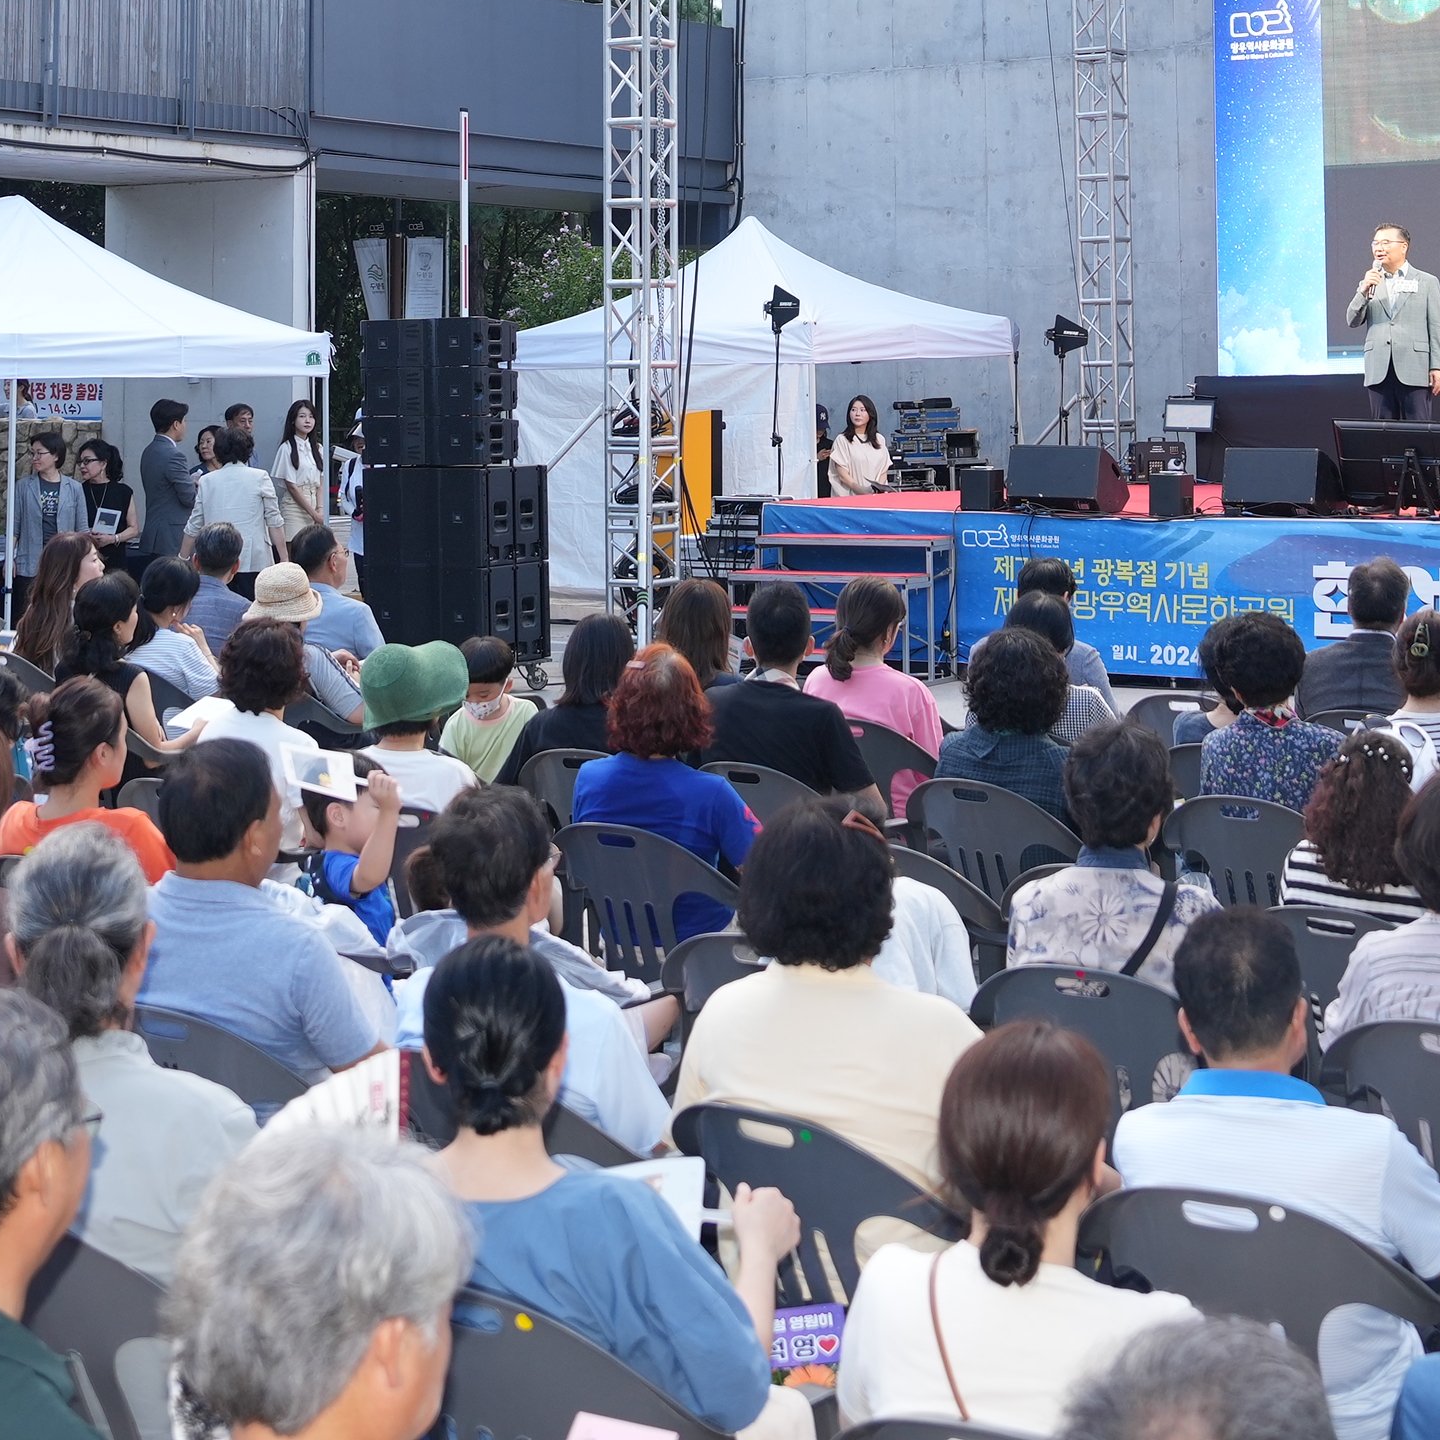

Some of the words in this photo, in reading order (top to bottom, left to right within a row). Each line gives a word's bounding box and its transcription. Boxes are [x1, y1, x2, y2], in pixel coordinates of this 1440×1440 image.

[1230, 38, 1294, 54] 망우역사문화공원
[50, 382, 74, 400] 차량
[1091, 559, 1157, 588] 광복절
[1164, 561, 1209, 589] 기념
[789, 1311, 834, 1332] 영원히
